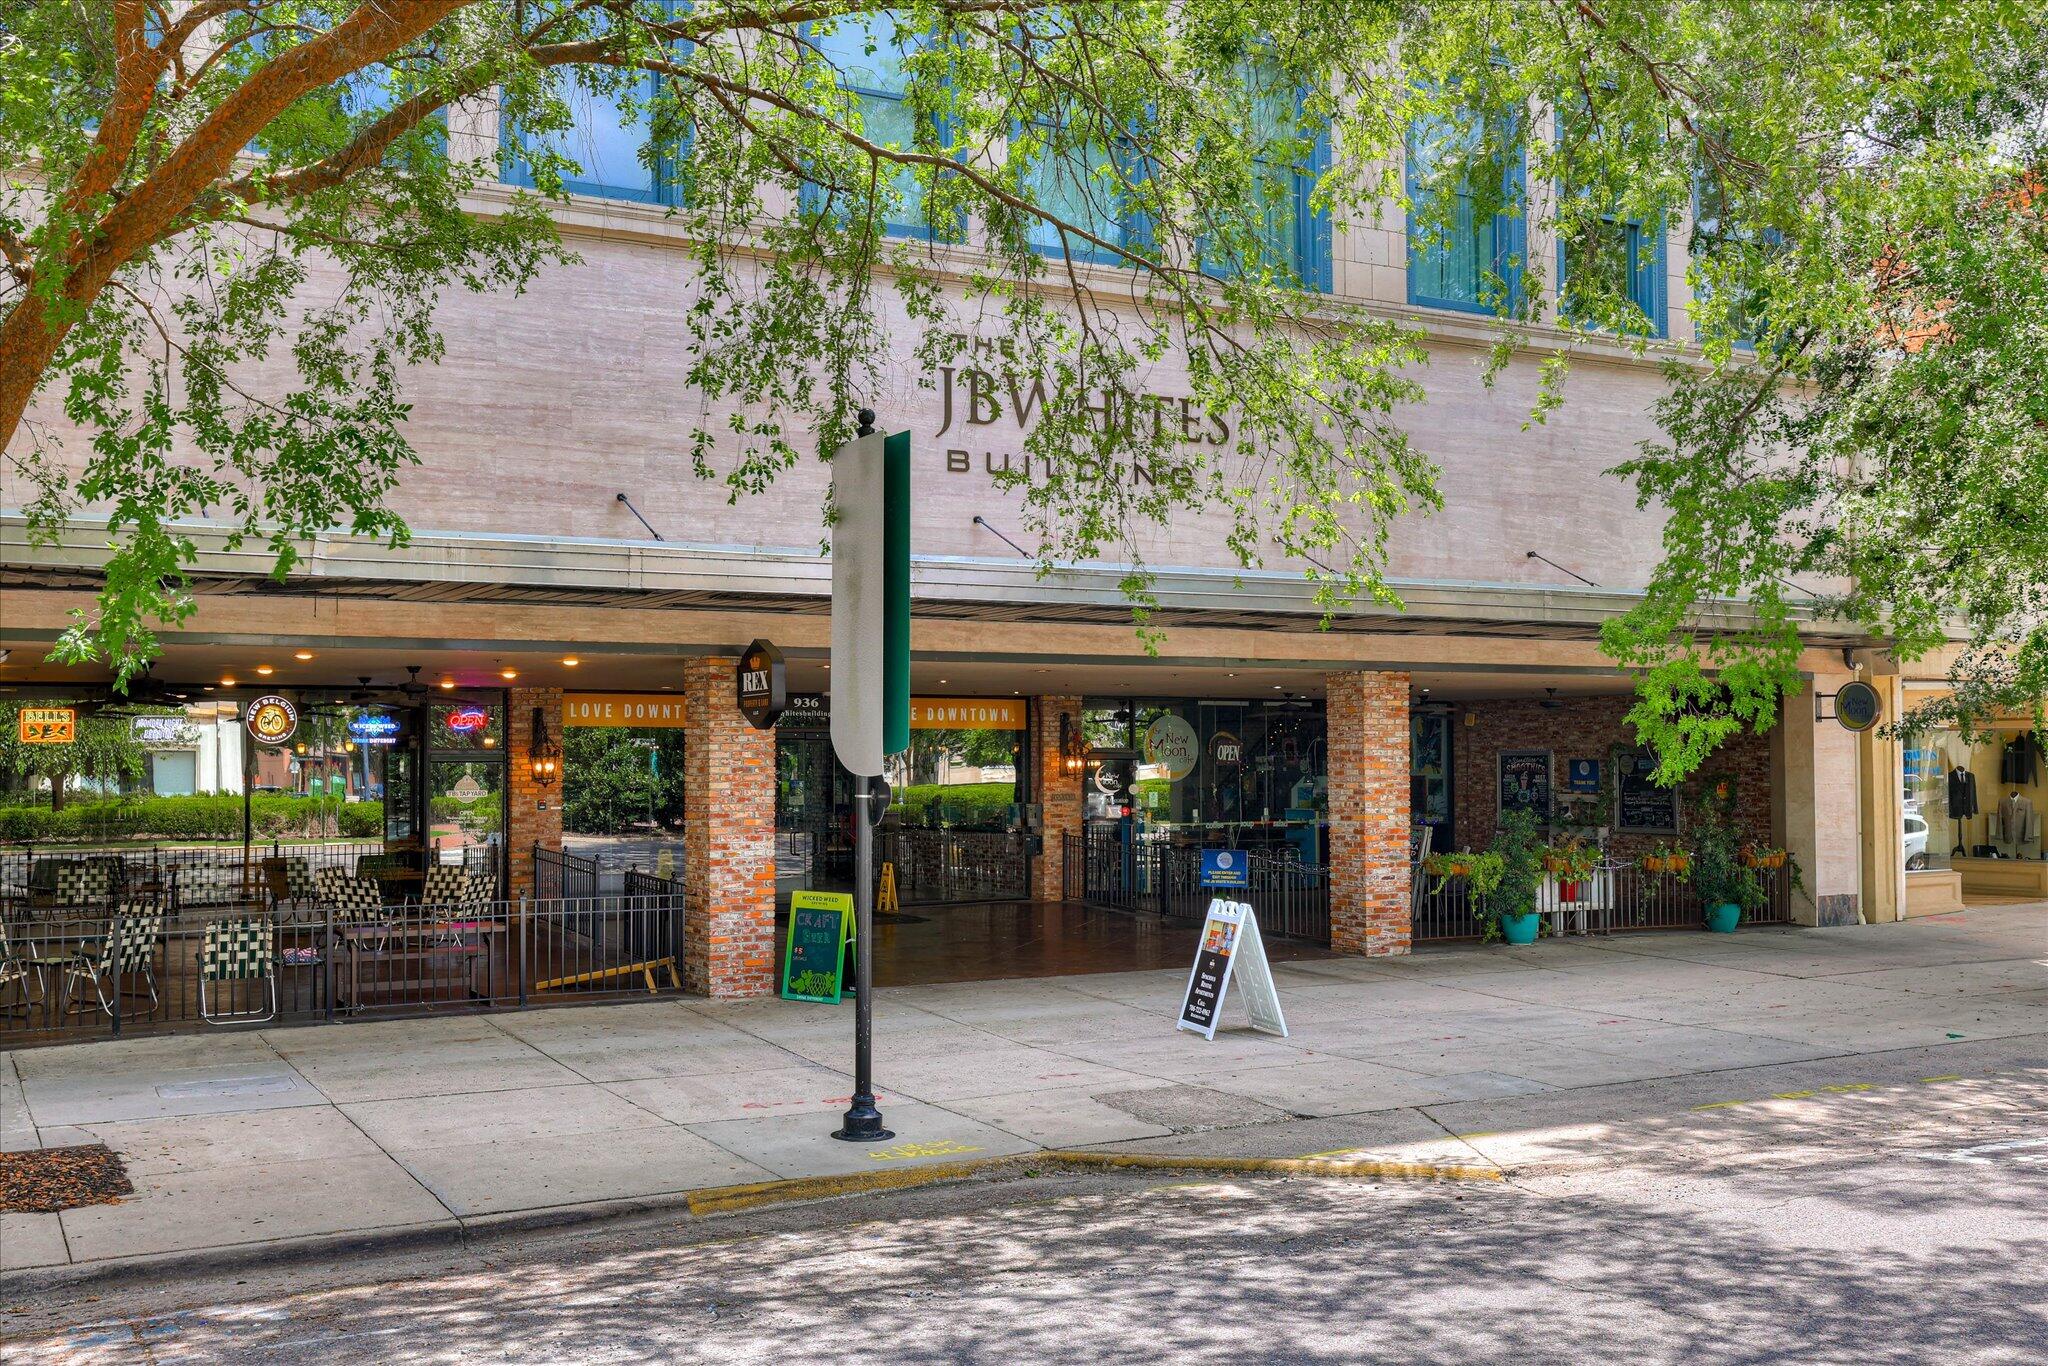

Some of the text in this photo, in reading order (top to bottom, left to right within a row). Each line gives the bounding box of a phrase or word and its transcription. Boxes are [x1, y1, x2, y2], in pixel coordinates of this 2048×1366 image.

[951, 333, 1016, 356] THE
[742, 670, 769, 692] REX
[248, 698, 295, 722] NEW BELGIUM
[793, 697, 820, 708] 936
[1840, 700, 1868, 715] Moon
[25, 711, 70, 723] BELL'S
[570, 702, 681, 719] LOVE DOWNT
[927, 707, 1016, 722] DOWNTOWN.
[450, 714, 484, 726] OPEN
[257, 732, 287, 741] BREWING
[1165, 733, 1189, 745] New
[1149, 738, 1188, 758] Moon
[1217, 744, 1240, 761] OPEN
